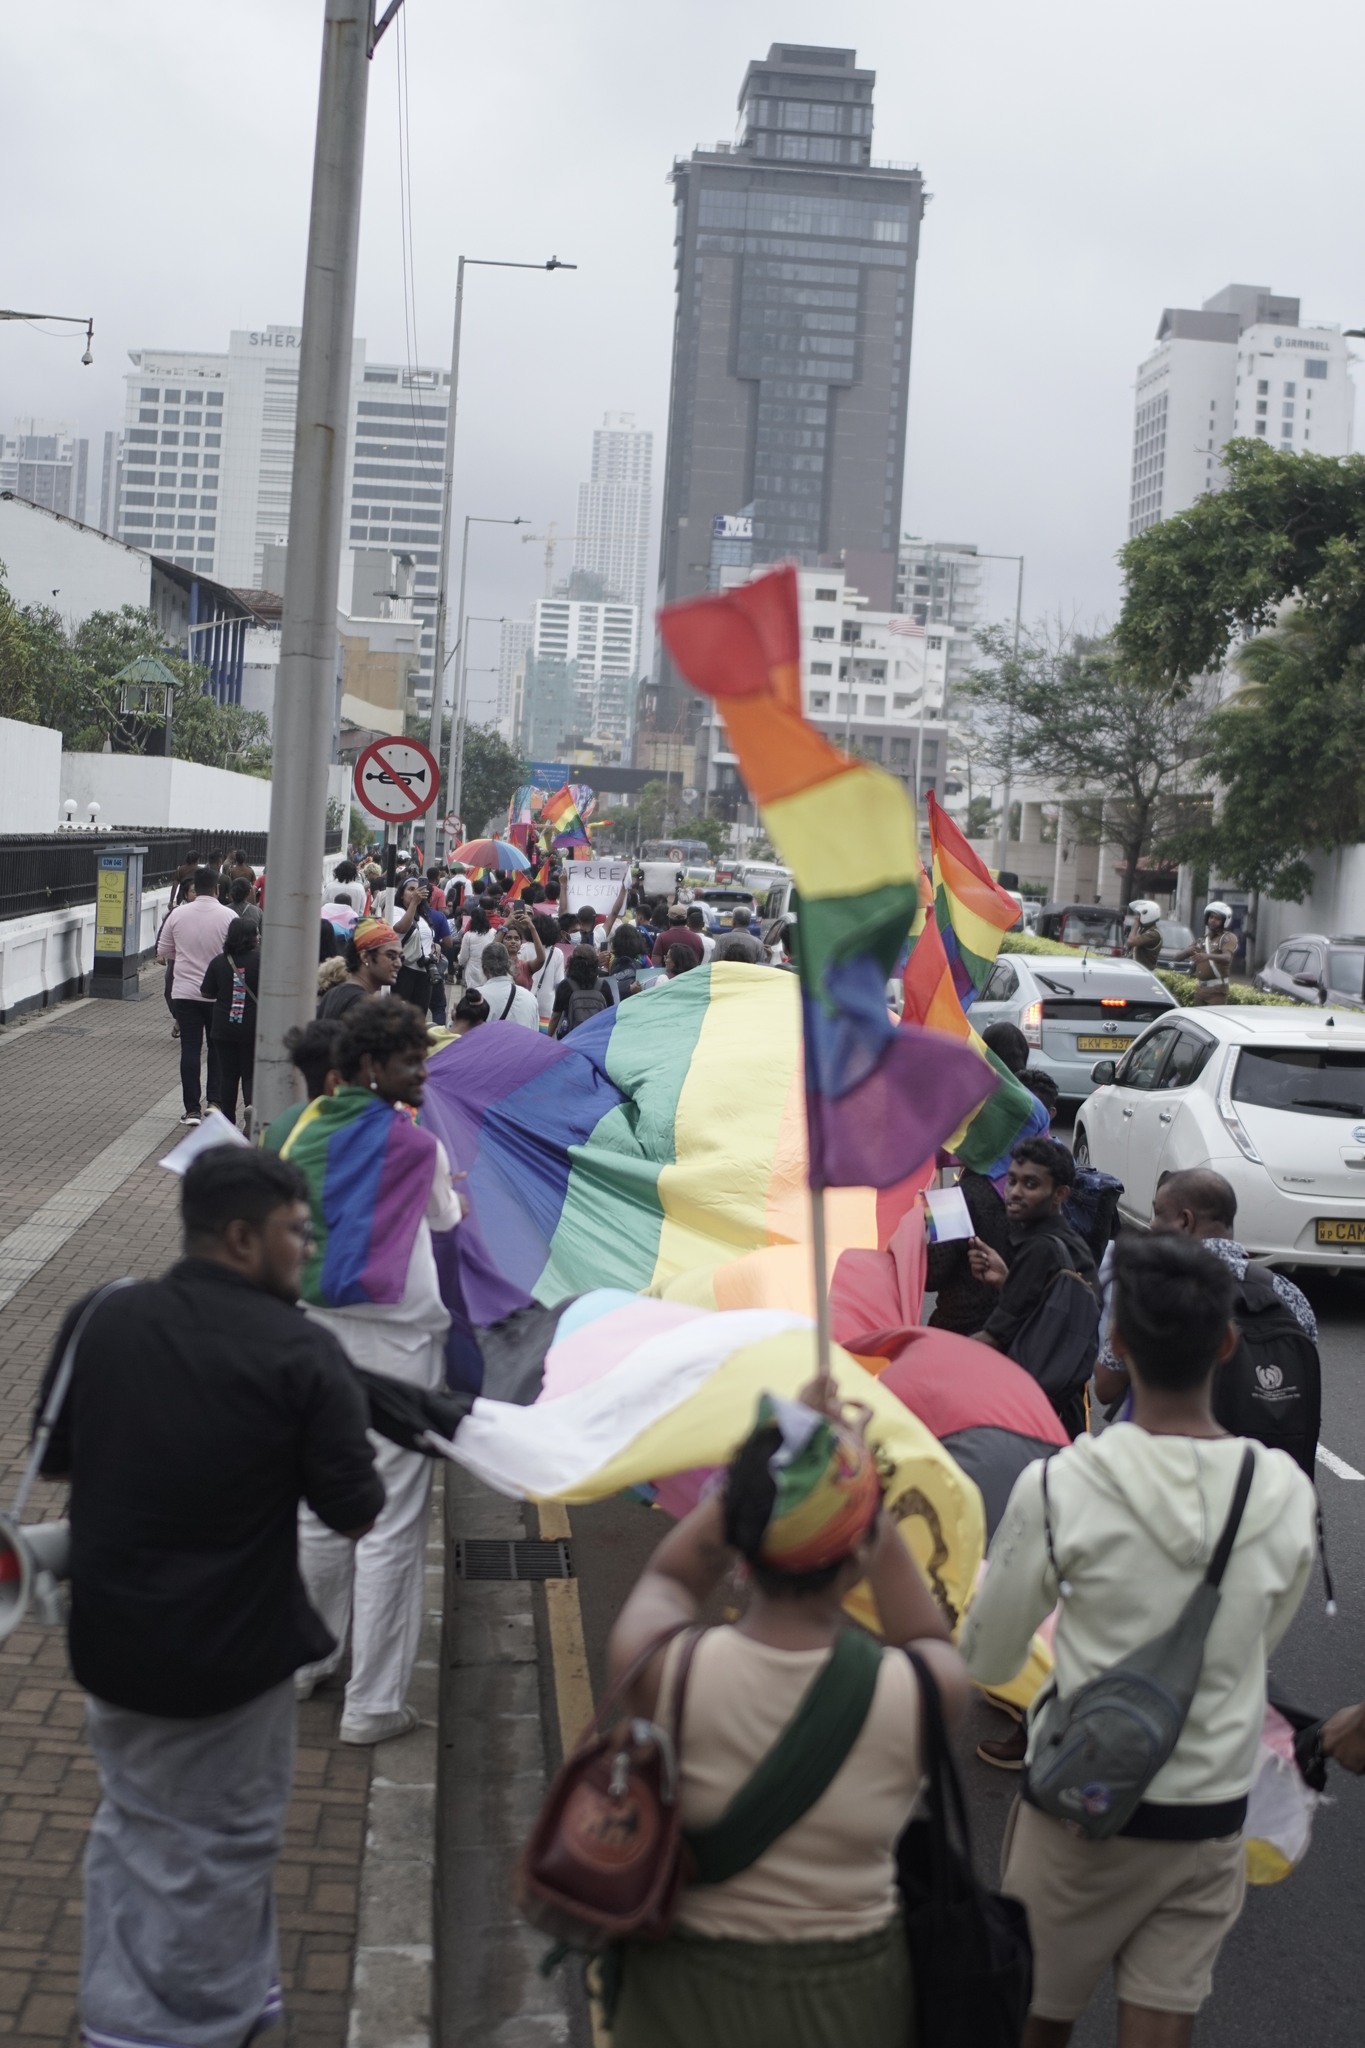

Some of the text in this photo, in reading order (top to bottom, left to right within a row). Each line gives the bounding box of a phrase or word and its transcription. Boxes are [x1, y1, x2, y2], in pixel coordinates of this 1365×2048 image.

[1285, 338, 1331, 351] GRANBELL
[568, 865, 621, 881] FREE
[565, 884, 619, 897] ALESTIN
[1111, 1039, 1135, 1049] 537
